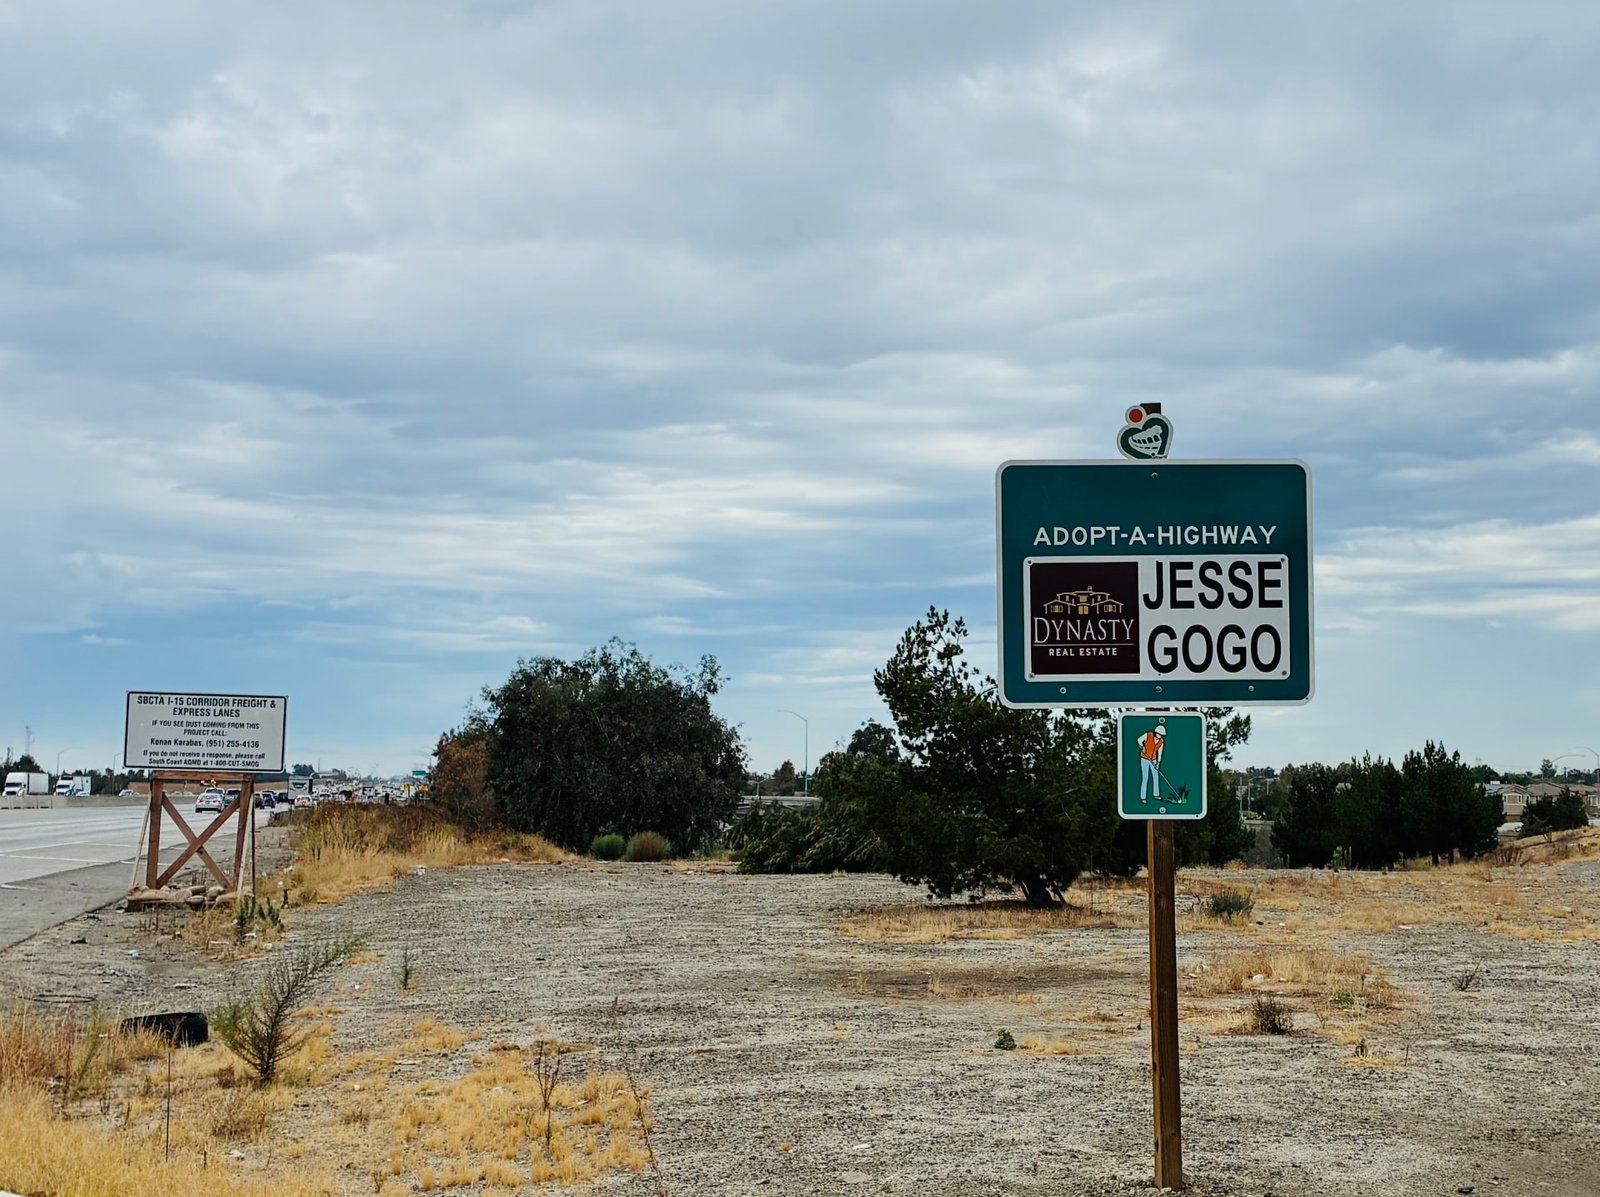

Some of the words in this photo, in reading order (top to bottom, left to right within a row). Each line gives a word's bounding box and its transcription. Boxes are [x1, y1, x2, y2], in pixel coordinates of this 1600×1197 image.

[1033, 525, 1277, 546] ADOPT-A-HIGHWAY
[1142, 560, 1283, 610] JESSE
[1033, 617, 1134, 643] DYNASTY
[1049, 648, 1074, 657] REAL
[1079, 647, 1117, 657] ESTATE
[1147, 623, 1282, 674] GOGO
[137, 696, 165, 705] SBCTA
[168, 696, 184, 705] I-15
[186, 697, 230, 707] CORRIDOR
[232, 699, 267, 708] FREIGHT
[270, 700, 276, 708] &
[173, 707, 210, 717] EXPRESS
[213, 709, 240, 718] LANES
[174, 739, 204, 747] Karabas,
[206, 740, 224, 748] (951)
[227, 740, 259, 748] 255-4136
